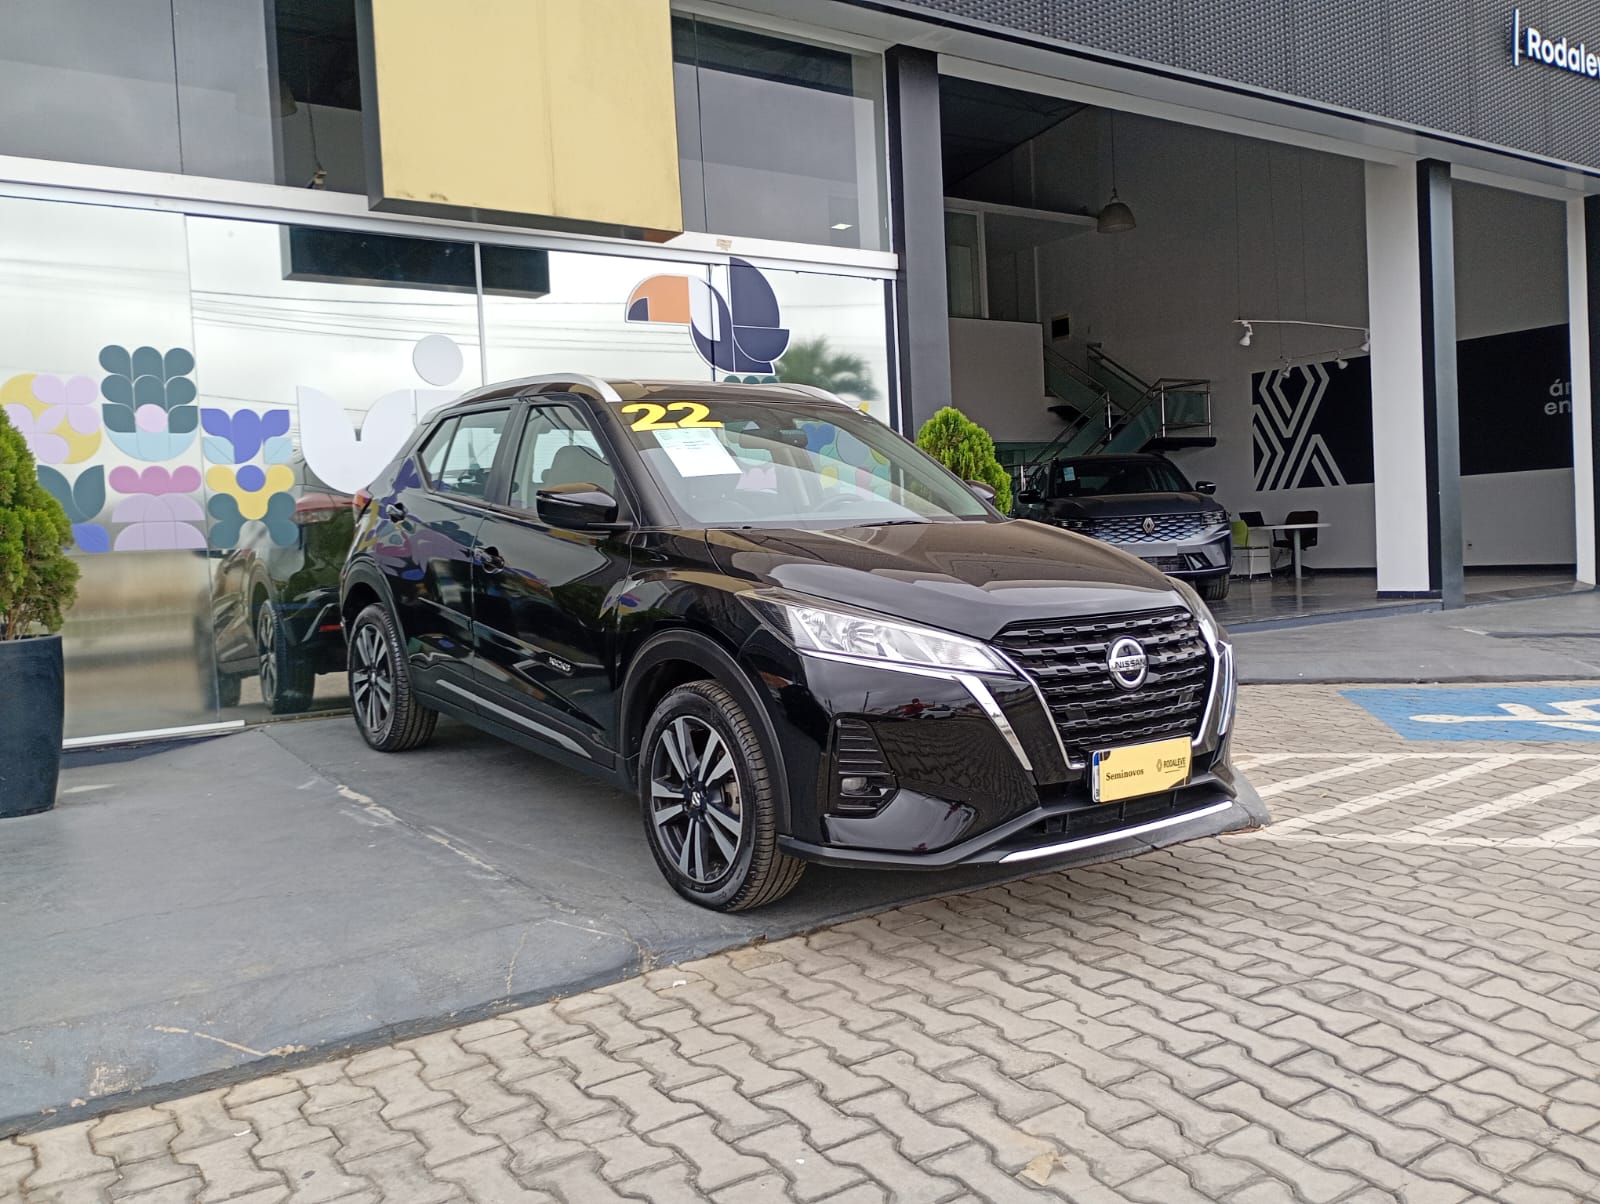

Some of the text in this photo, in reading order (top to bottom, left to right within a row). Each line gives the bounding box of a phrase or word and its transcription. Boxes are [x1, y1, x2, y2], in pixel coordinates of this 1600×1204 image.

[621, 402, 724, 432] 22
[1114, 659, 1146, 669] NISSAN
[1163, 757, 1187, 769] RODALEVE
[1105, 768, 1145, 782] Seminovos
